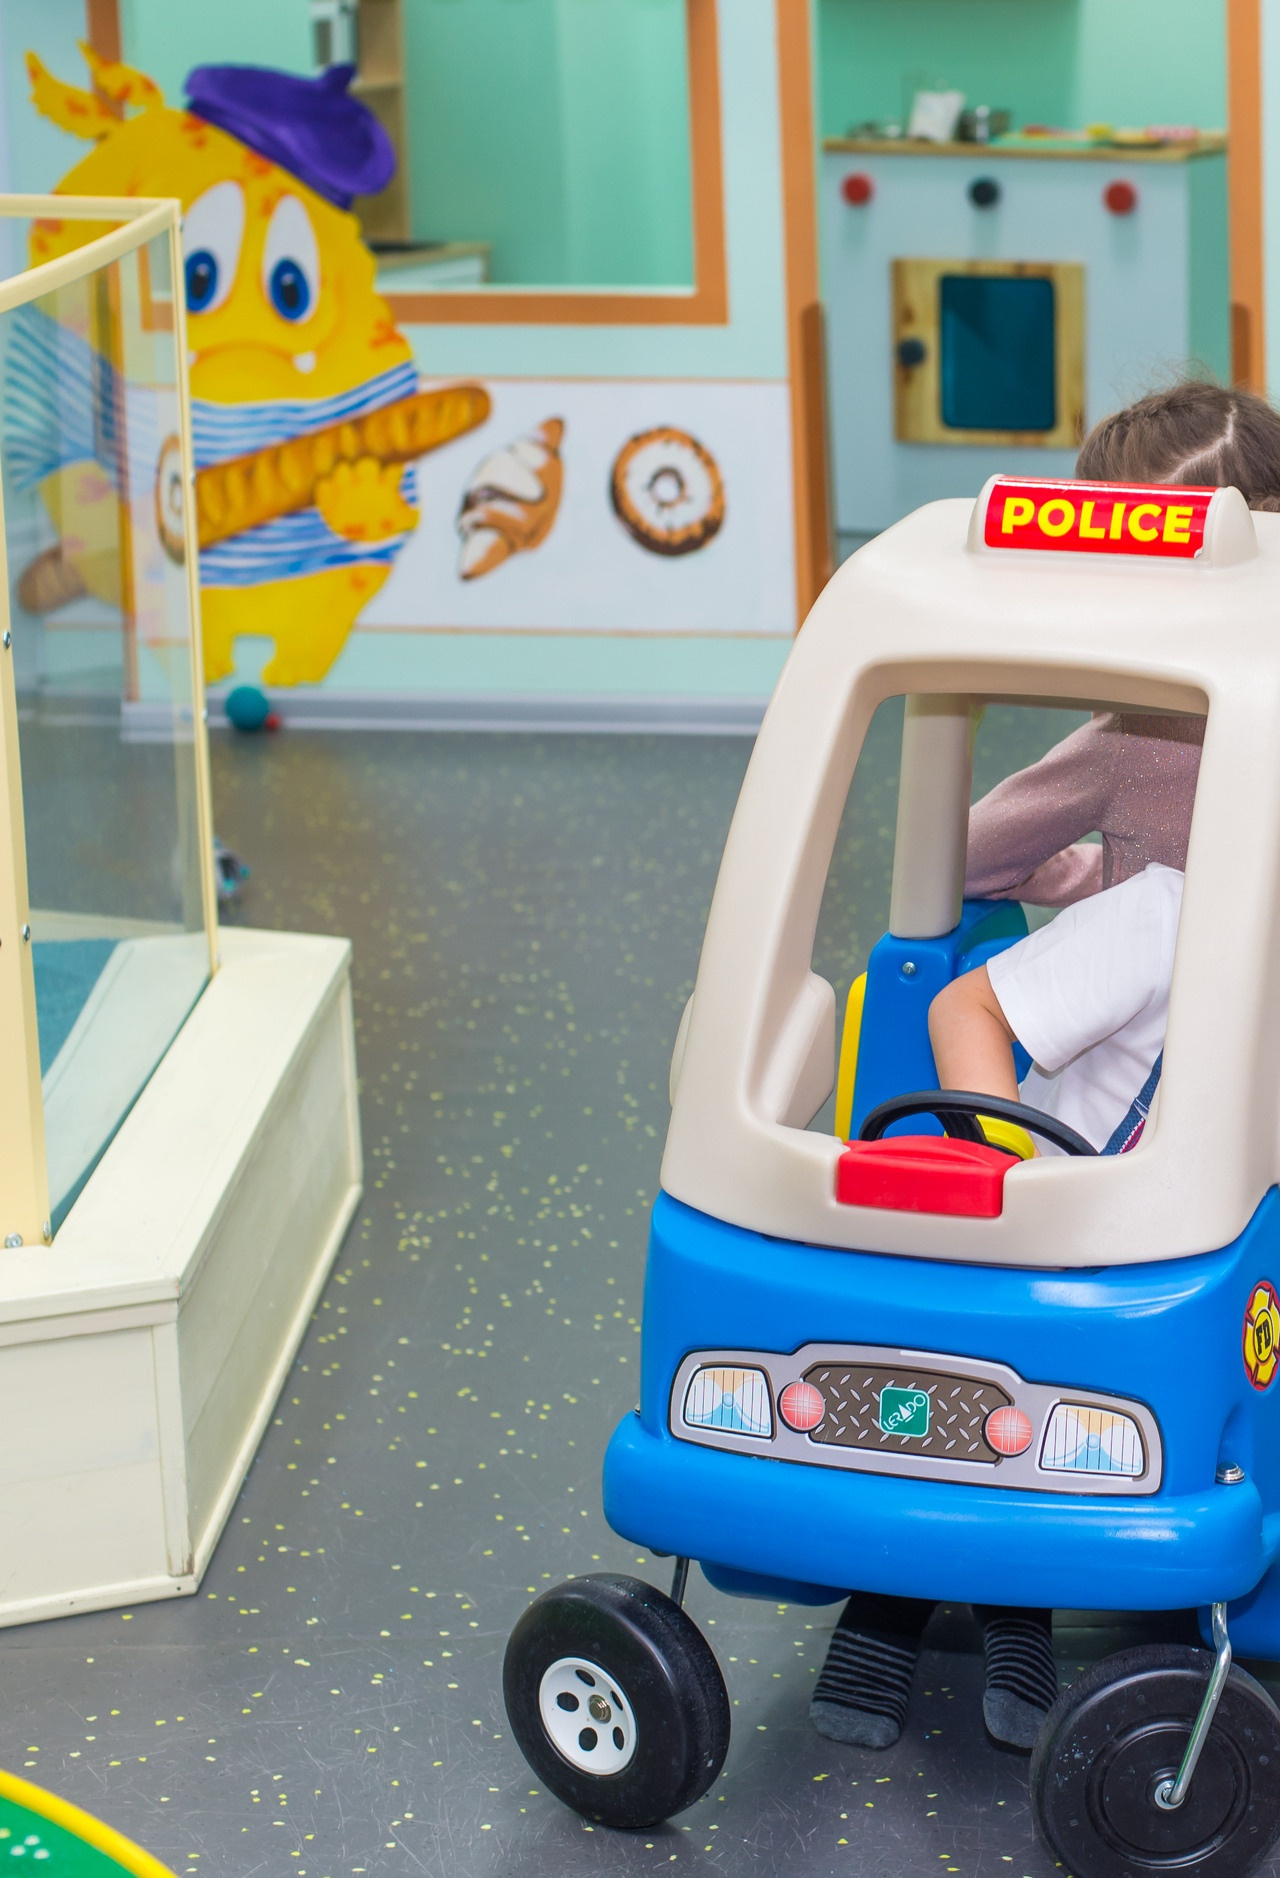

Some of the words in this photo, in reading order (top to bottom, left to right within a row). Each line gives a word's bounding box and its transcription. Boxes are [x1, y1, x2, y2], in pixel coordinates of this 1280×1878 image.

[1001, 497, 1194, 544] POLICE
[1255, 1318, 1272, 1356] FD
[883, 1394, 926, 1430] LERADO
